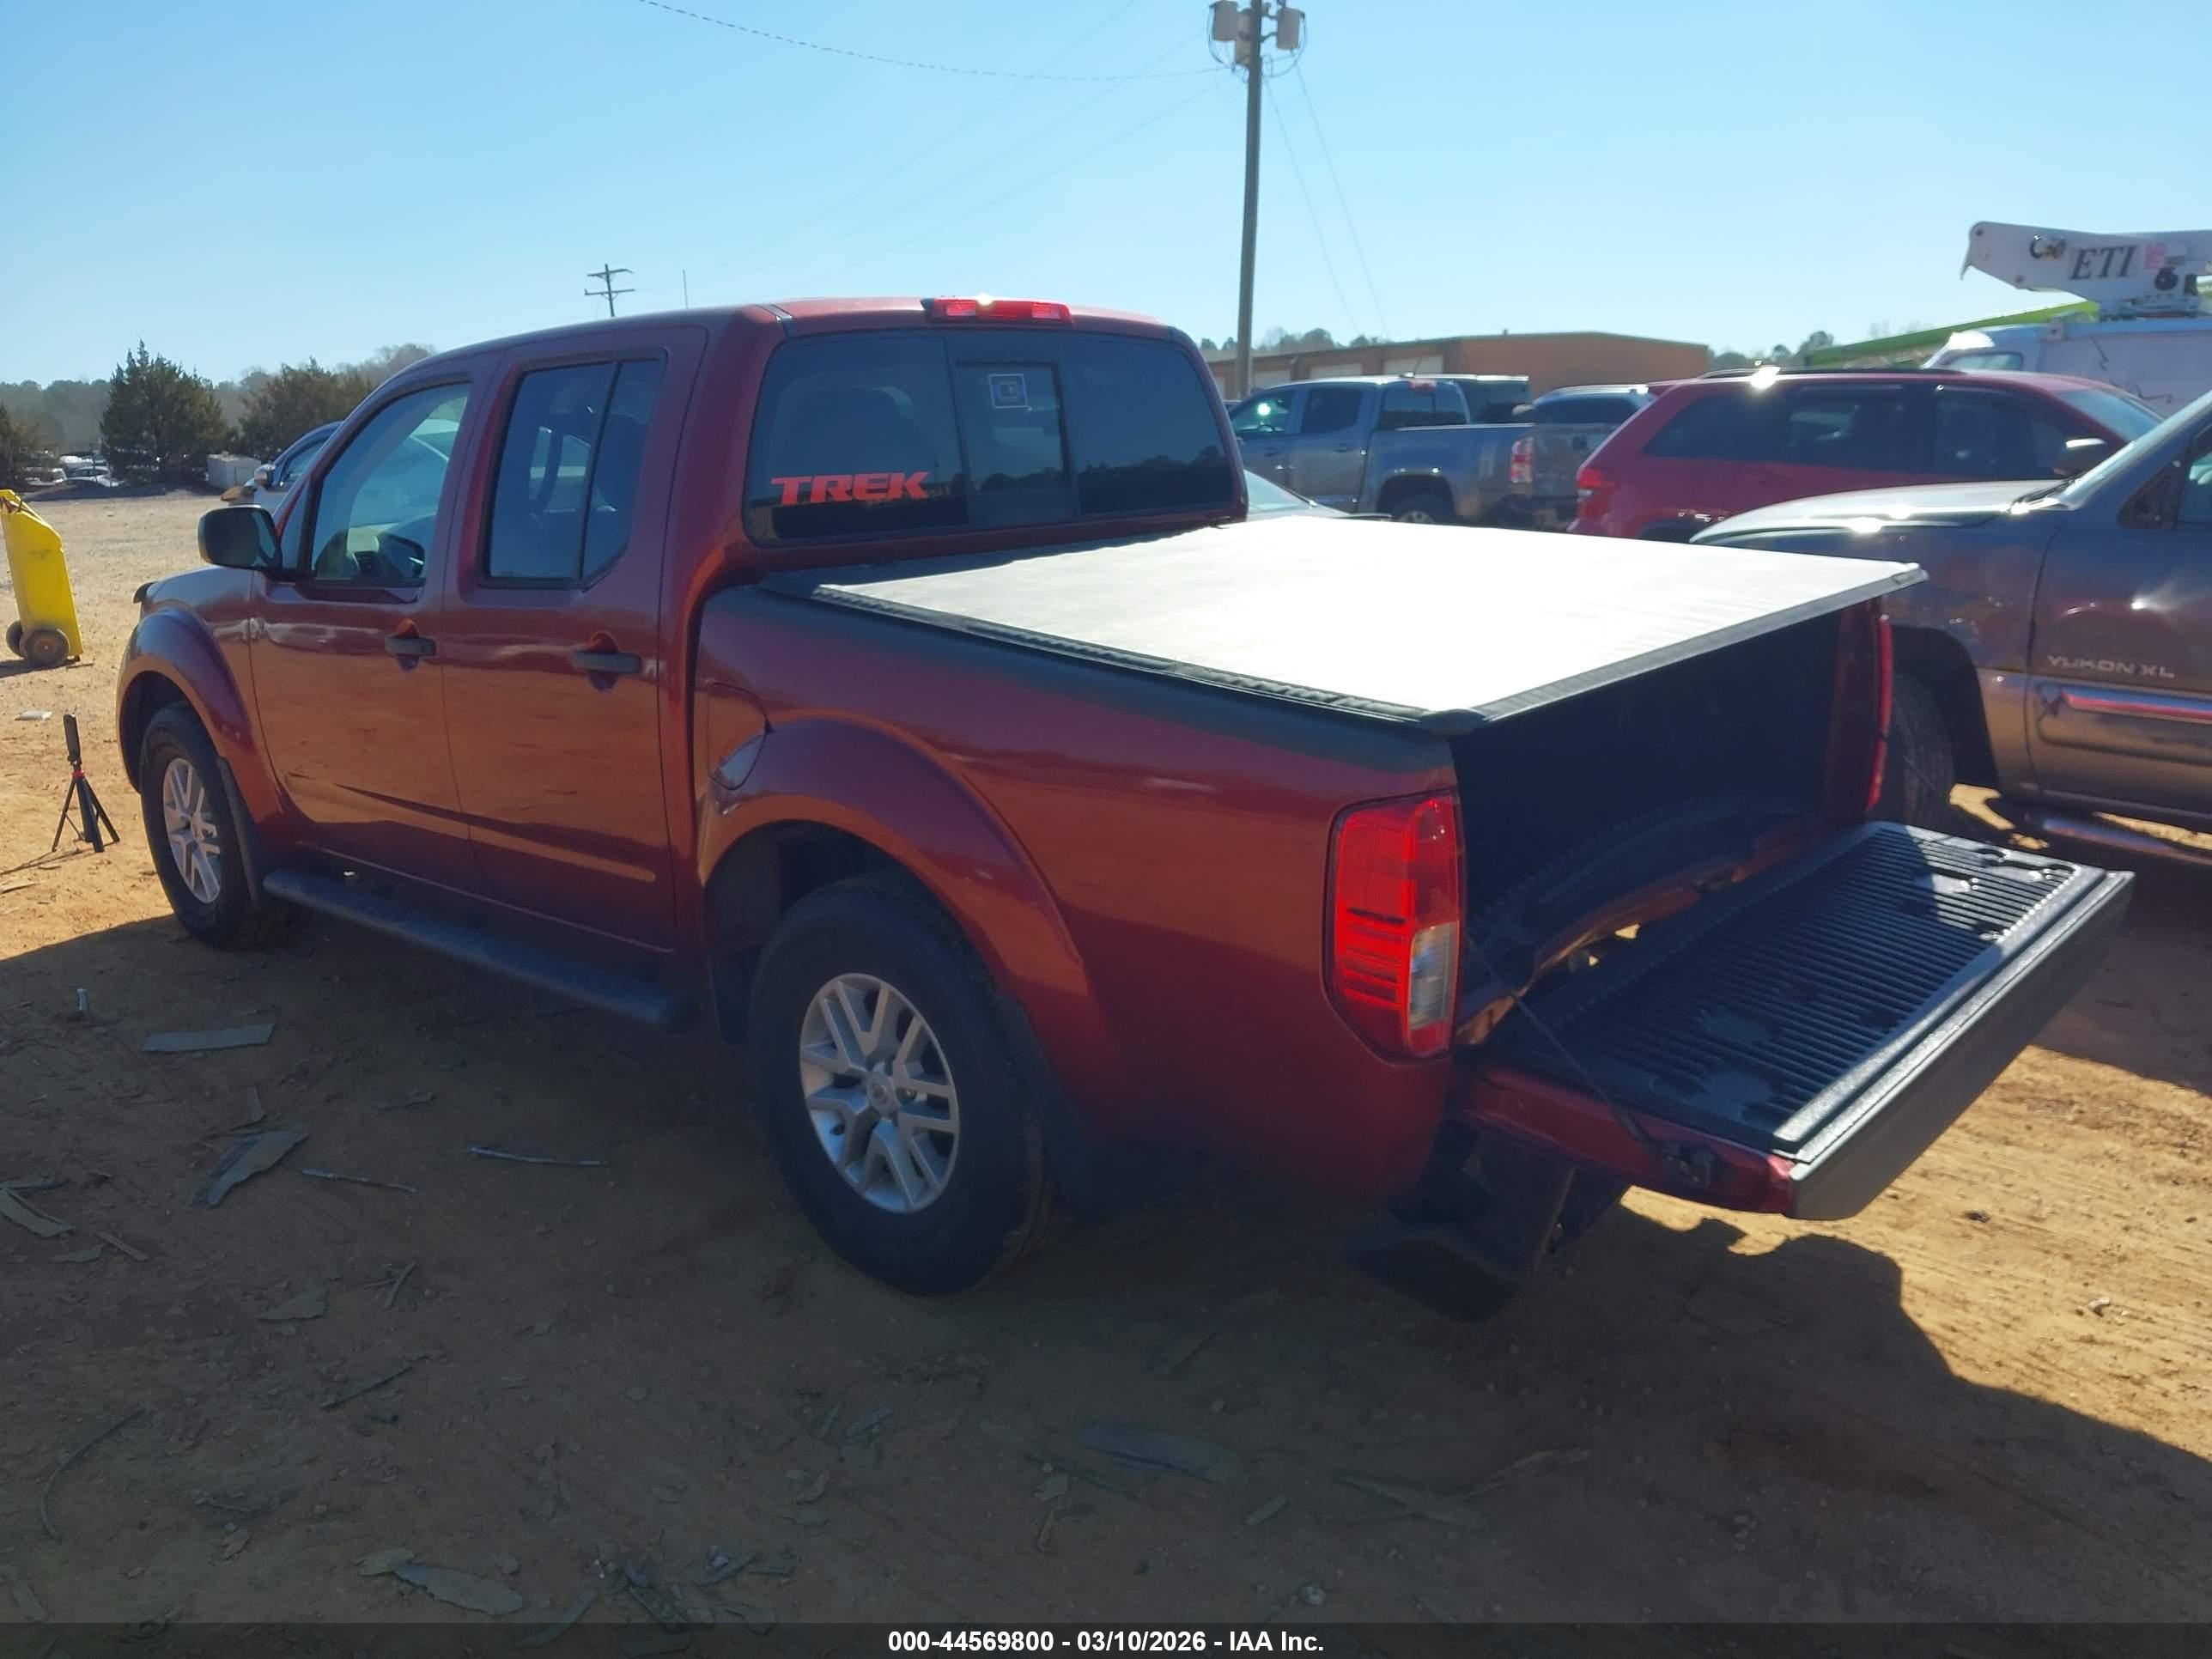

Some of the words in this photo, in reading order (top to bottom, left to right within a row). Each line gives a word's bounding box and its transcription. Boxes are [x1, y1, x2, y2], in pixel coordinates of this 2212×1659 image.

[2069, 245, 2138, 281] ETI
[770, 471, 930, 505] TREK
[2047, 654, 2135, 674] YUKON
[2139, 663, 2175, 679] XL
